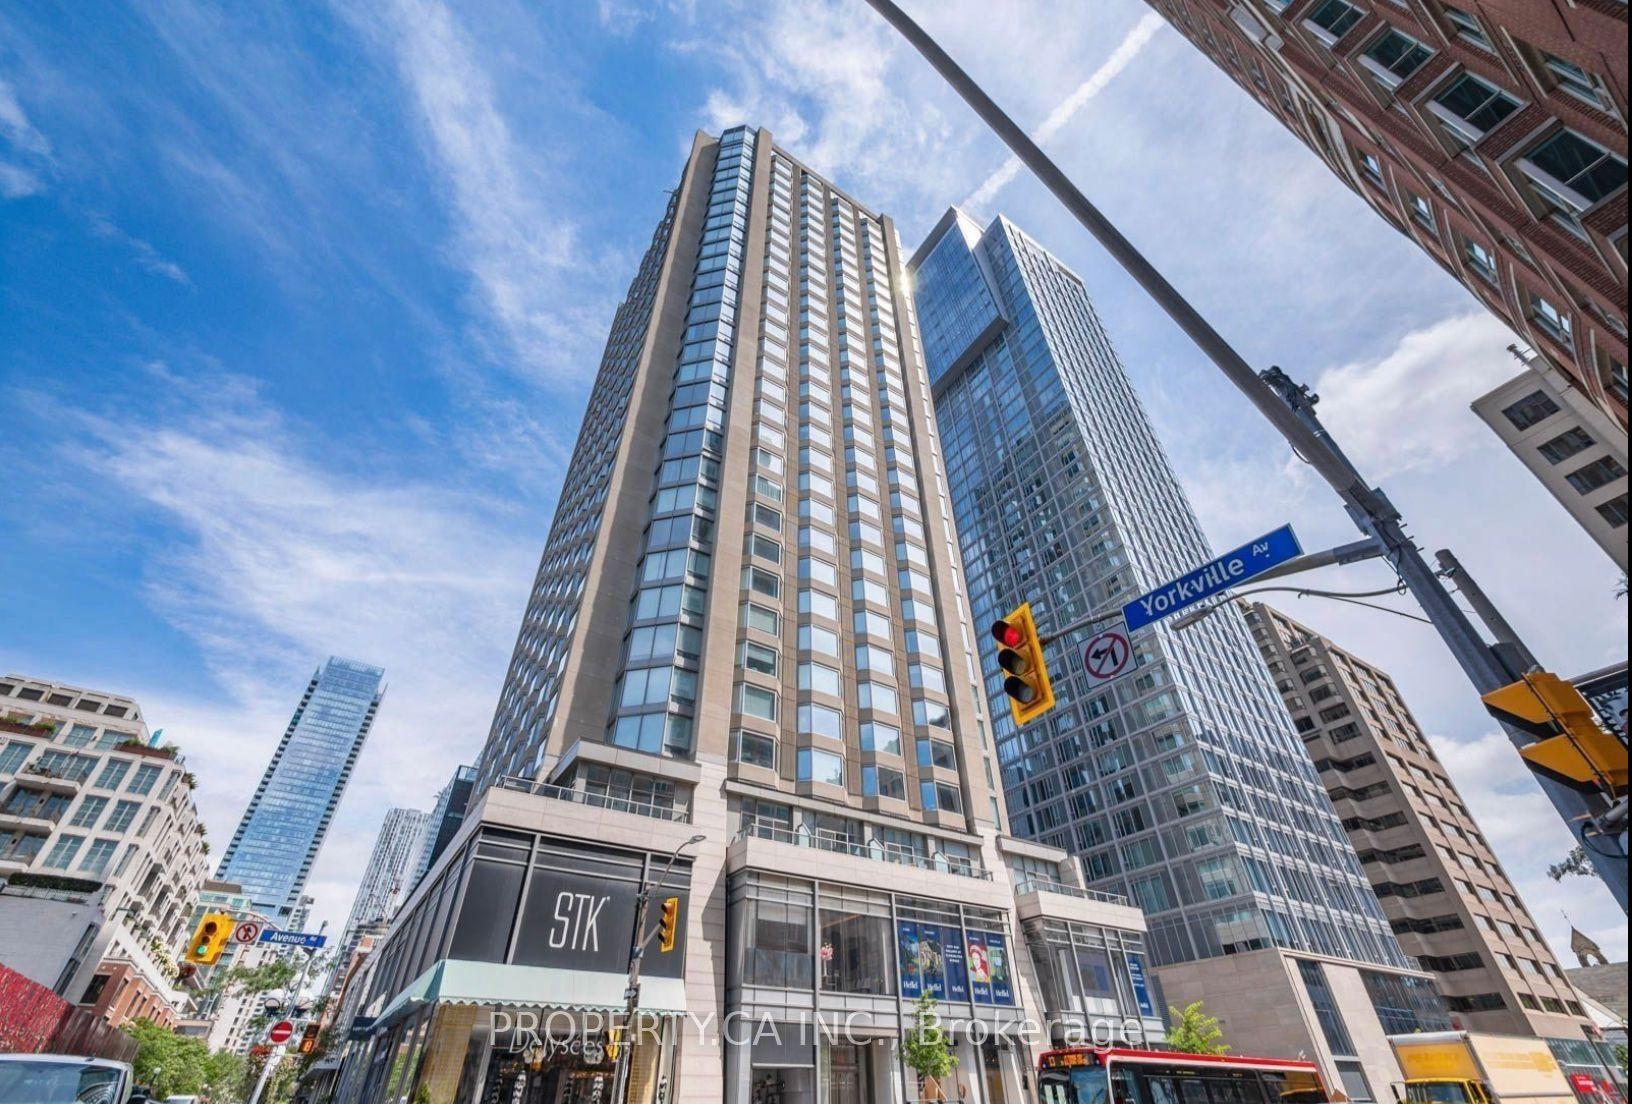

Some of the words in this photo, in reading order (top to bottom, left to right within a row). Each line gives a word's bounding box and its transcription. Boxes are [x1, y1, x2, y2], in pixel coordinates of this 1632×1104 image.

[1140, 558, 1245, 616] Yorkville
[1252, 541, 1269, 557] Av
[270, 932, 307, 944] Avenue
[549, 891, 605, 951] STK
